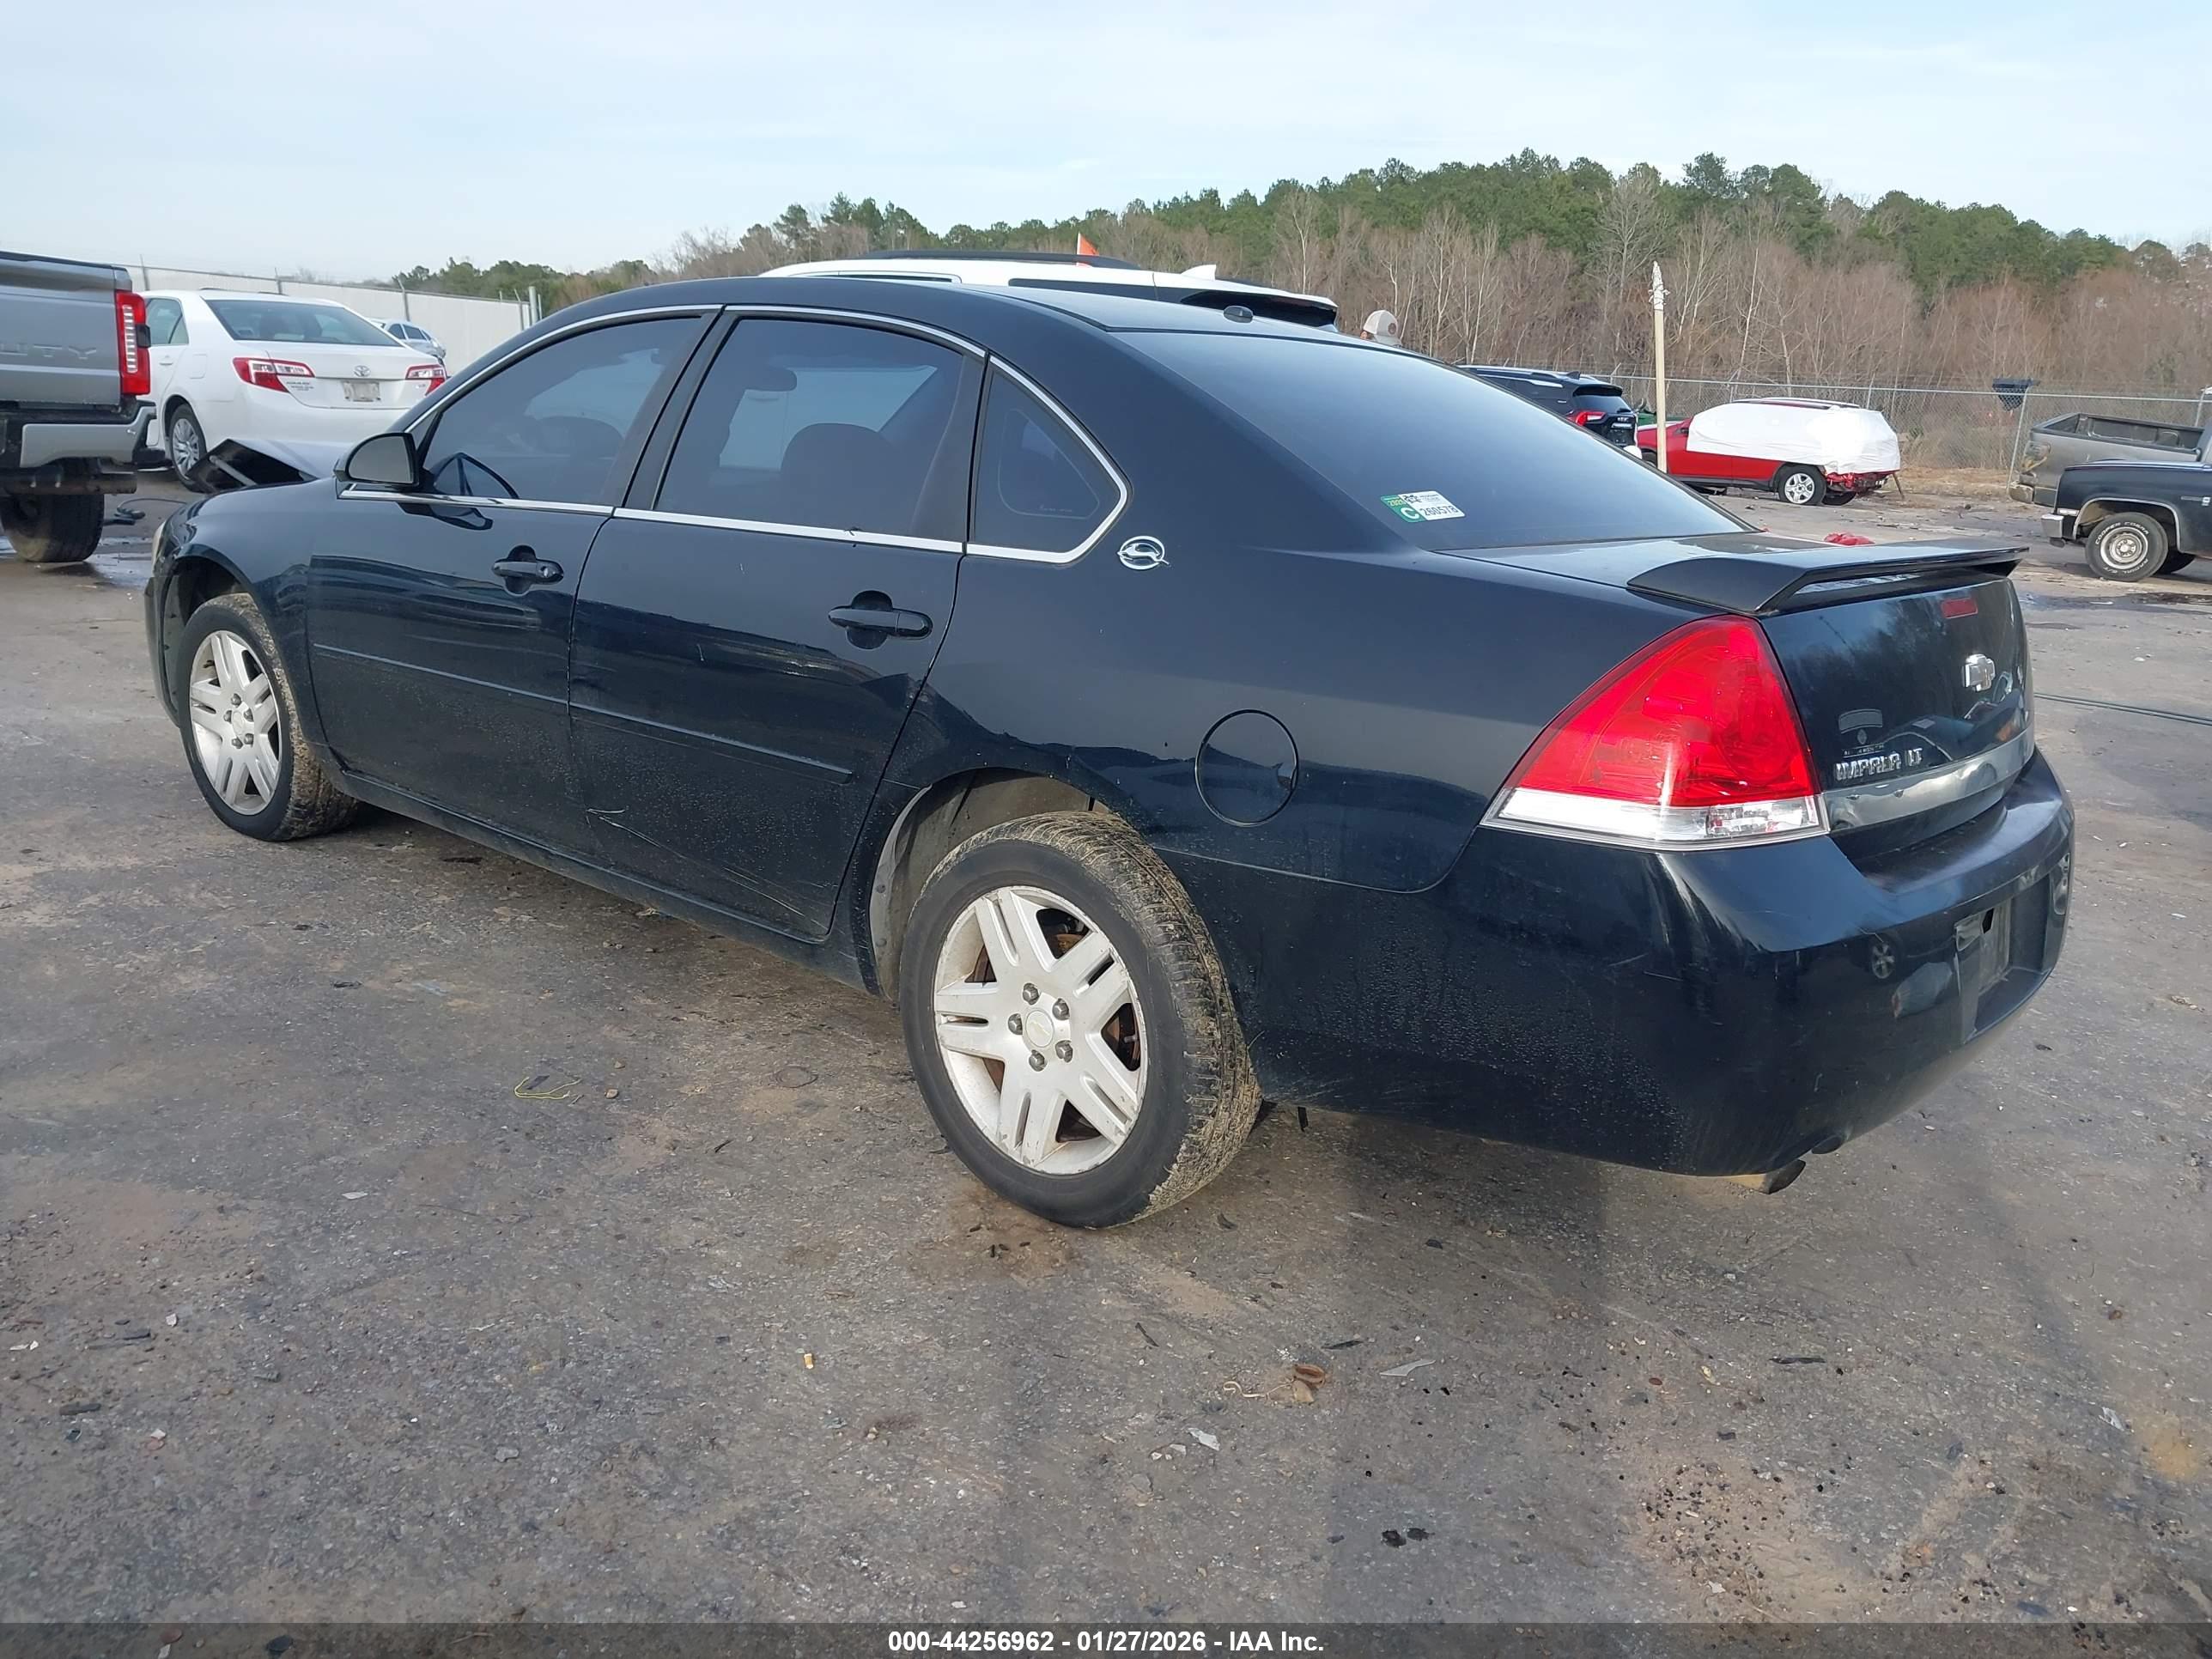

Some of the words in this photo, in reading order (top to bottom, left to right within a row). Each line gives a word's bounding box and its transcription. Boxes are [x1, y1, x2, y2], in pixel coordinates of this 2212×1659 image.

[1400, 507, 1420, 520] C
[2095, 521, 2121, 545] COOPER
[2124, 521, 2149, 535] COBRA
